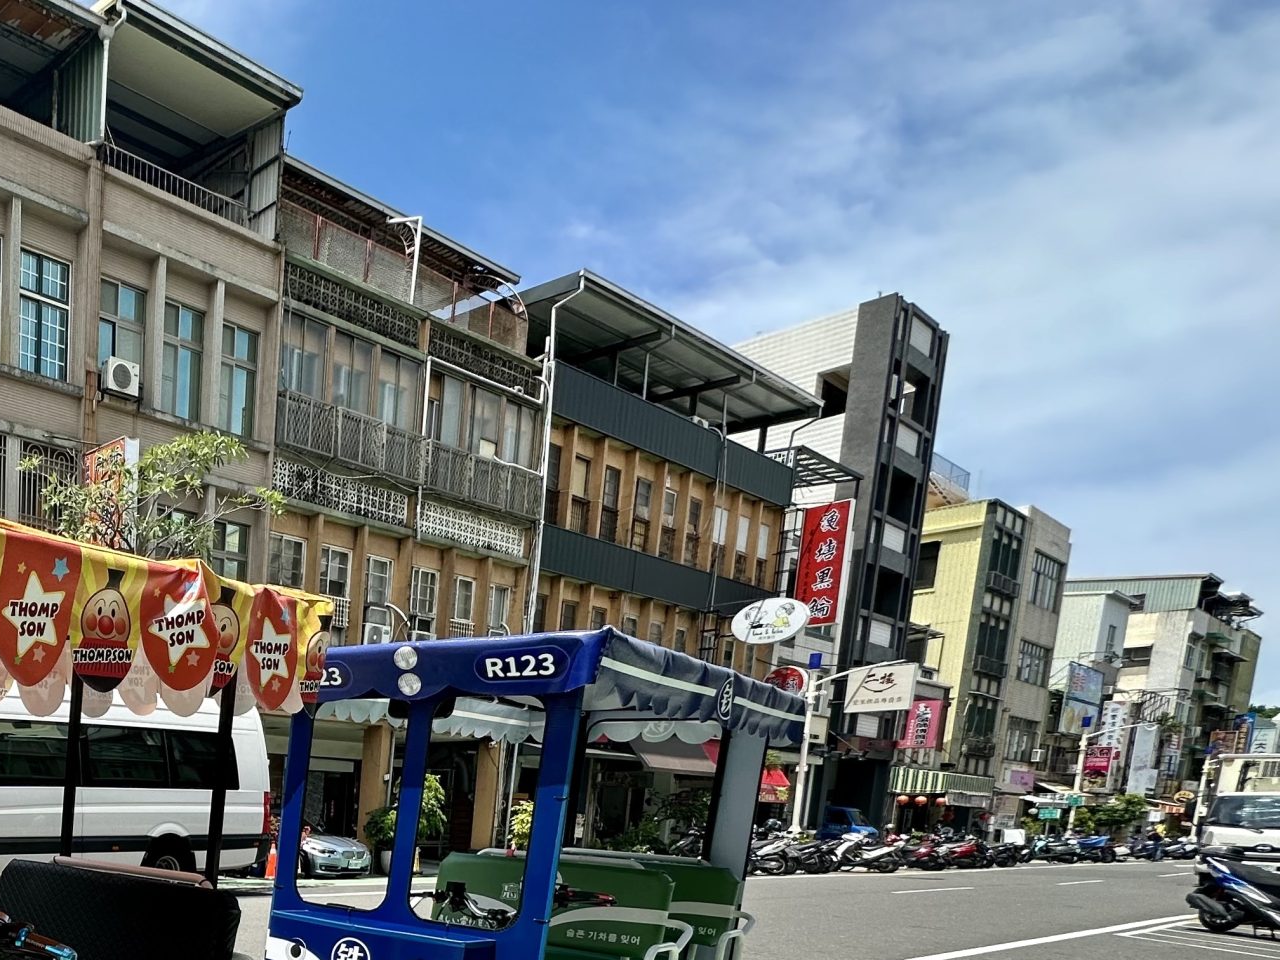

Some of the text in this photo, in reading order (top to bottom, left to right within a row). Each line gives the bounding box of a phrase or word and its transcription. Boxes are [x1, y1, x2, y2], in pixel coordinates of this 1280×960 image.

[10, 600, 59, 618] THOMP
[153, 610, 205, 632] THOMP
[19, 621, 46, 637] SON
[169, 630, 195, 647] SON
[254, 641, 288, 656] THOMP
[72, 649, 133, 664] THOMPSON
[261, 656, 280, 671] SON
[485, 653, 556, 678] R123
[588, 931, 617, 944] 기차를
[620, 934, 641, 946] 잊어
[697, 925, 717, 937] 잊어
